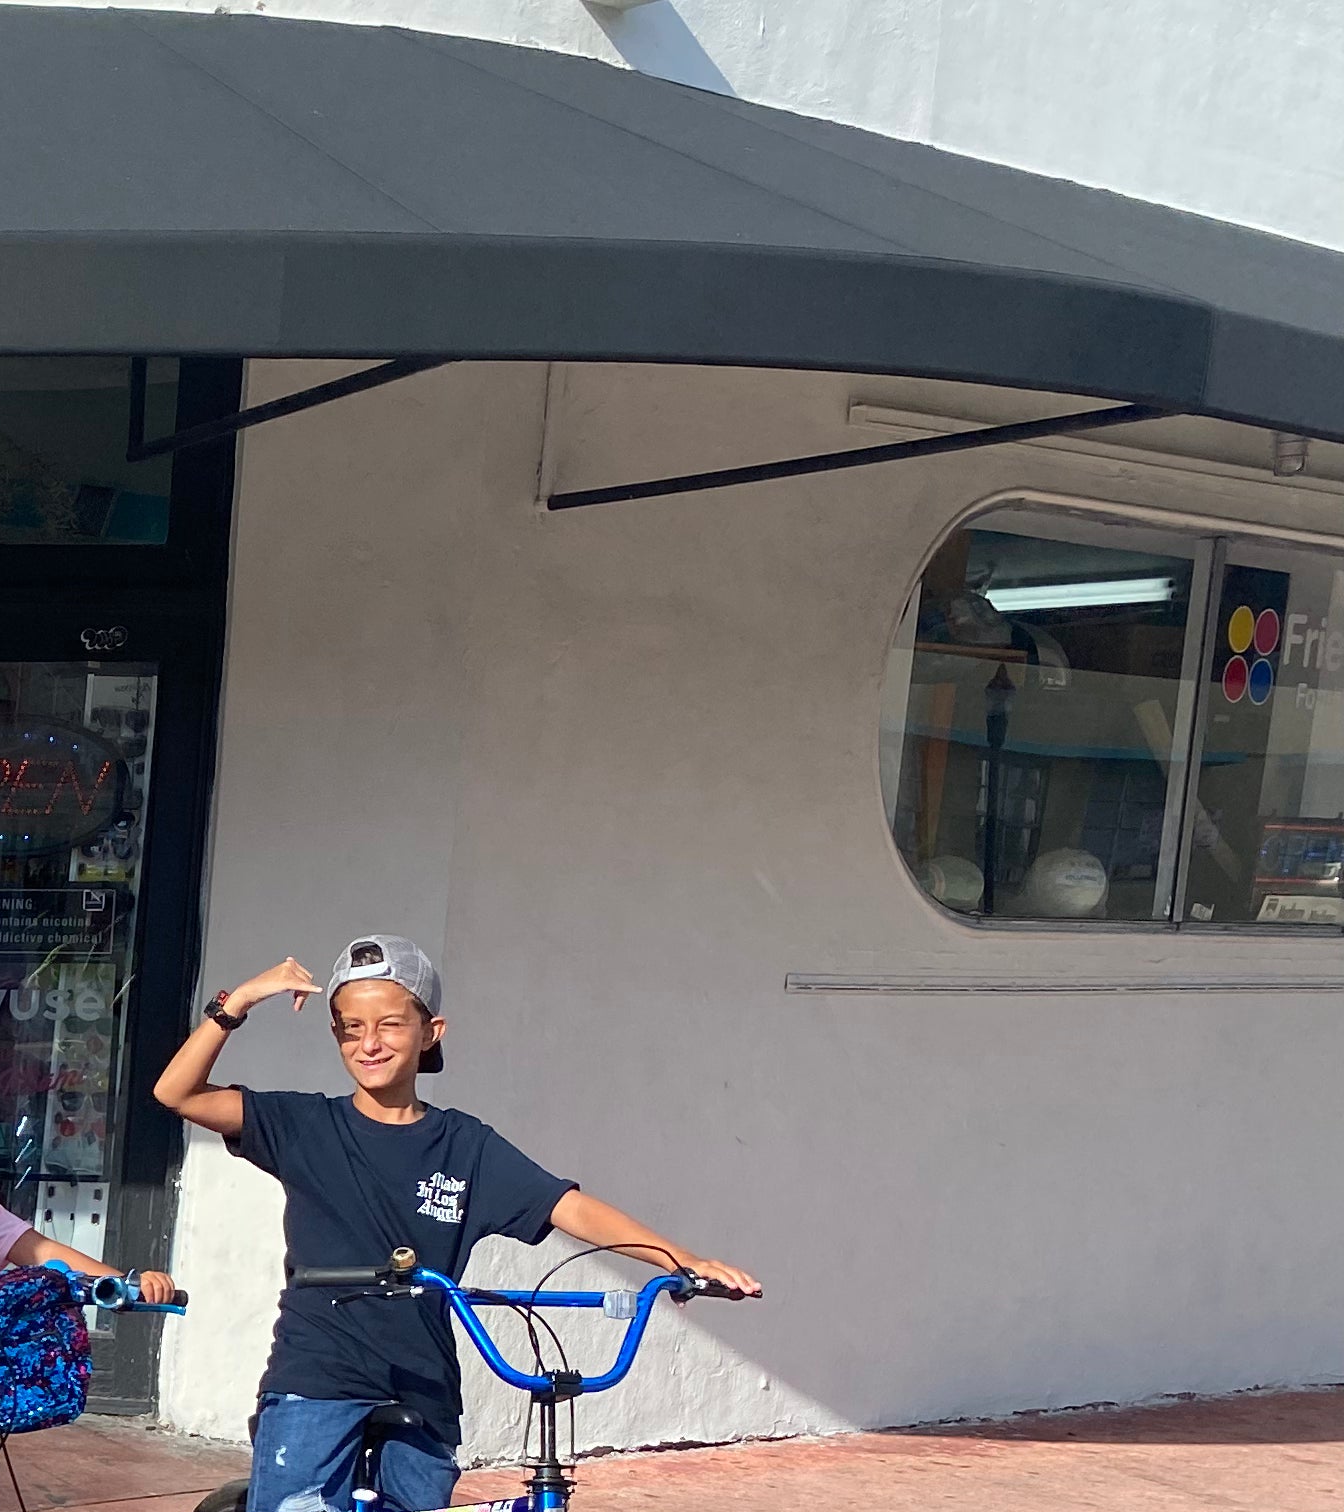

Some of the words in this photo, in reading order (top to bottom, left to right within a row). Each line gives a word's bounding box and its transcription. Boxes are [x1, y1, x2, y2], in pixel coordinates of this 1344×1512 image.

[416, 1181, 433, 1200] In
[432, 1189, 459, 1207] Los
[428, 1171, 466, 1193] Made
